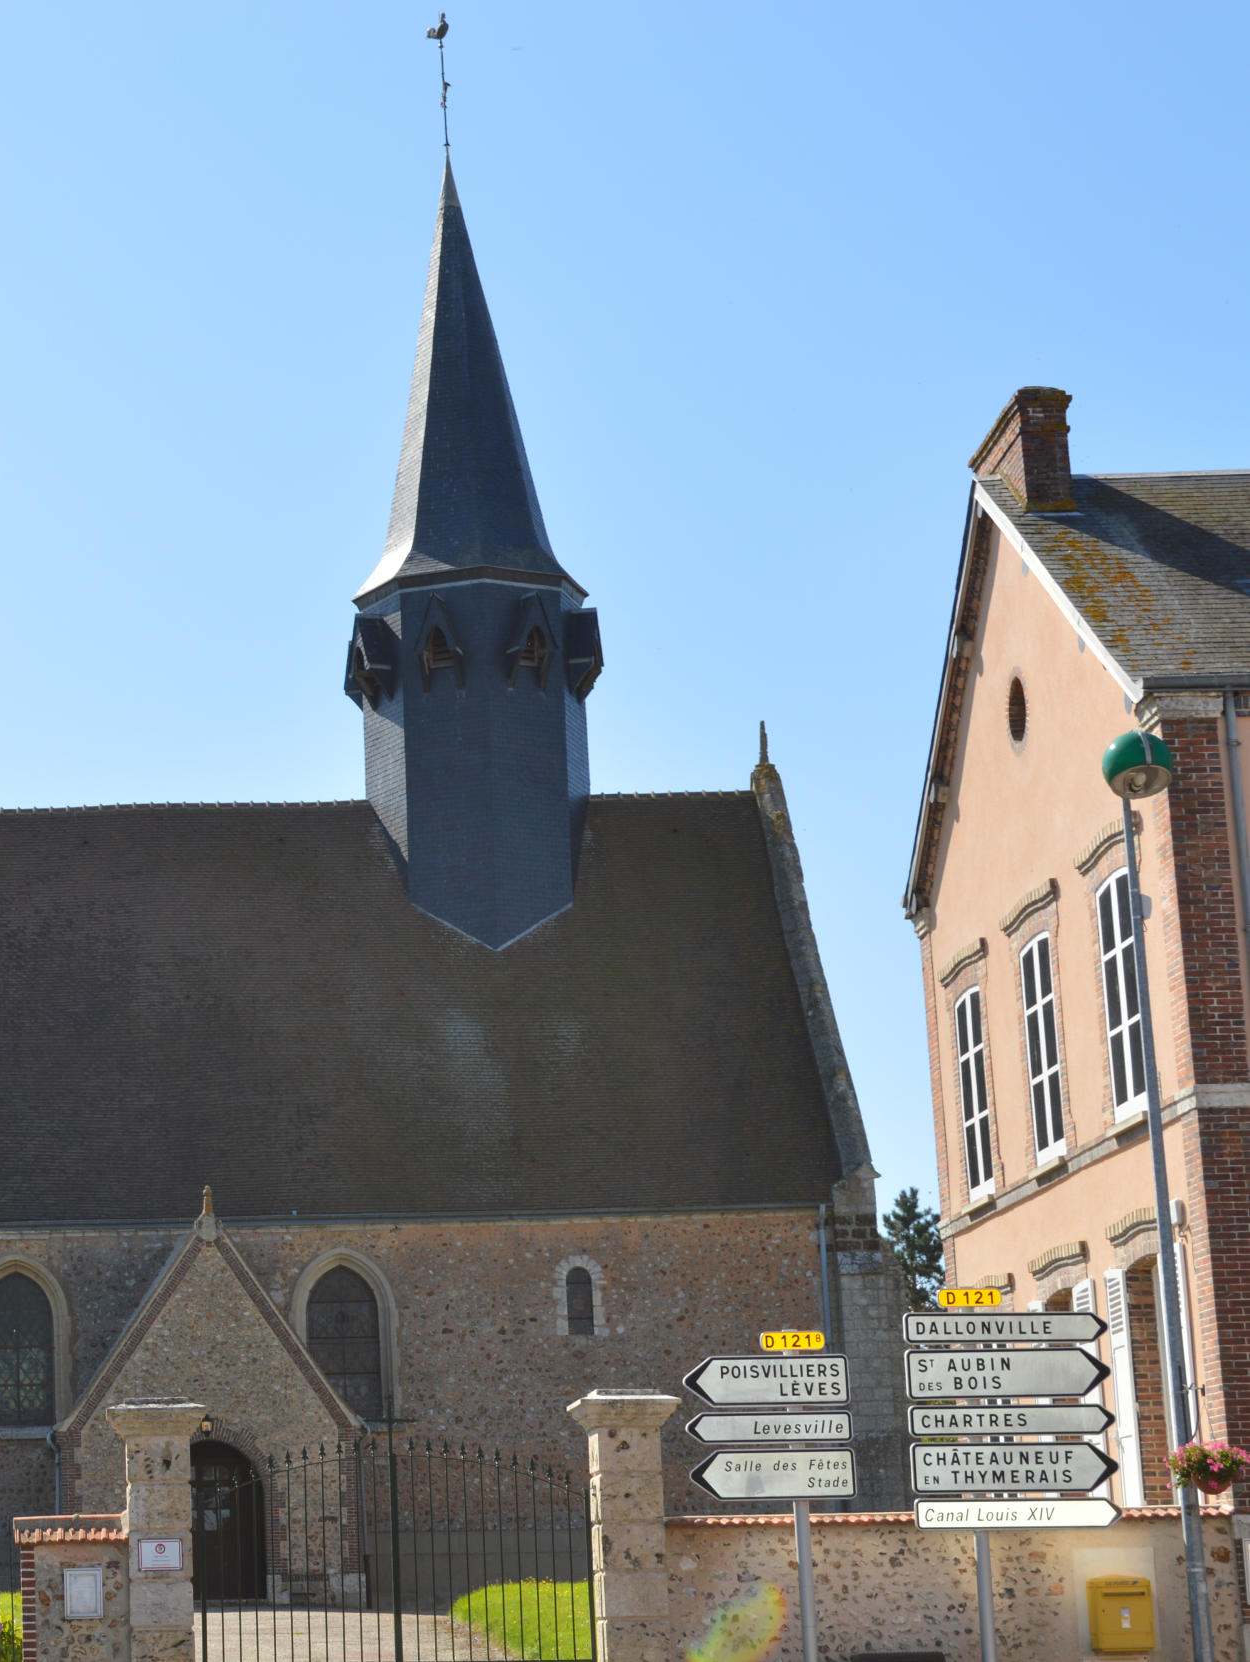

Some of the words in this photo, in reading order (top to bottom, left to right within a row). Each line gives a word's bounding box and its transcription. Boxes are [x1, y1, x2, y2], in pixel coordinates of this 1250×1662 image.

[946, 1292, 956, 1305] D
[963, 1291, 995, 1305] 121
[915, 1321, 1053, 1336] DALLONVILLE
[765, 1335, 775, 1348] D
[720, 1363, 840, 1379] POISVILLIERS
[947, 1357, 1012, 1372] AUBIN
[780, 1380, 842, 1397] LÈVES
[918, 1381, 943, 1392] DES
[953, 1375, 1002, 1391] BOIS
[753, 1419, 844, 1435] Levesville
[921, 1413, 1028, 1429] CHARTRES
[724, 1460, 763, 1472] Salle
[772, 1460, 797, 1471] des
[808, 1458, 848, 1471] Fêtes
[922, 1449, 1074, 1467] CHÂTEAUNEUF
[807, 1476, 849, 1488] Stade
[924, 1475, 940, 1485] EN
[950, 1469, 1073, 1485] THYMERAIS
[924, 1508, 970, 1522] Canal
[977, 1507, 1018, 1521] Louis
[1026, 1506, 1056, 1521] XIV
